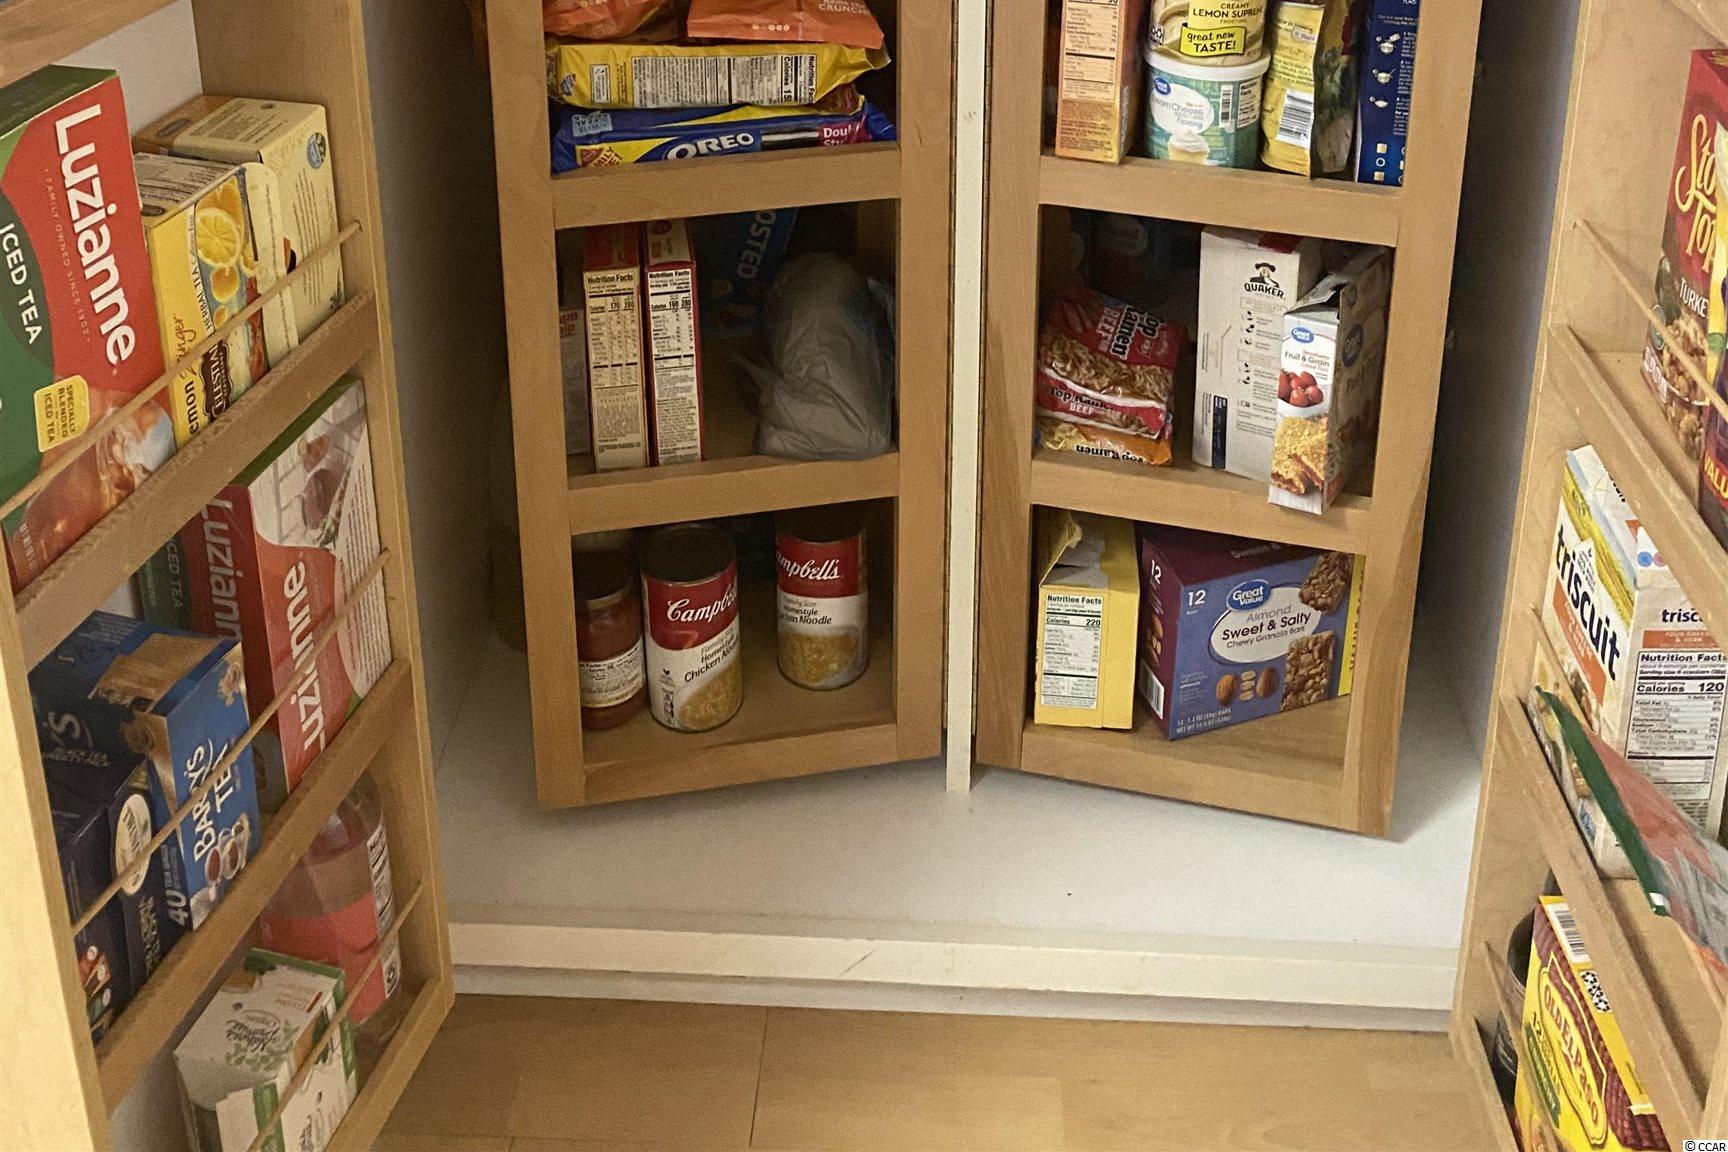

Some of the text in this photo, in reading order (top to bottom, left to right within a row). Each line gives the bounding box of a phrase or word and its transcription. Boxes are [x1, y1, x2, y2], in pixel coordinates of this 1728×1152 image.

[1193, 8, 1229, 18] LEMON
[1187, 31, 1236, 43] great new
[1193, 40, 1237, 53] TASTE!
[783, 55, 791, 87] Calories
[808, 55, 816, 85] Nutrition
[666, 132, 755, 161] OREO
[55, 102, 136, 366] Luzianne
[0, 223, 43, 345] ICED TEA
[588, 273, 634, 284] Nutrition Facts
[649, 271, 674, 279] Nutrition
[1244, 282, 1286, 299] QUAKER
[198, 294, 213, 331] HERBAL
[1284, 351, 1301, 361] Fruit
[1308, 356, 1330, 367] Grain
[44, 392, 56, 443] ICED TEA
[57, 387, 69, 439] BLENDED
[66, 384, 76, 434] SPECIALLY
[1068, 402, 1094, 415] BEEF
[1075, 444, 1120, 459] Ramen
[1150, 559, 1162, 585] 12
[1047, 594, 1102, 605] Nutrition Facts
[1187, 590, 1206, 607] 12
[1232, 584, 1265, 603] Great
[1239, 593, 1264, 607] Value
[1556, 524, 1620, 682] triscuit
[799, 615, 833, 624] Noodle
[1046, 617, 1101, 627] Calories 220
[1246, 604, 1292, 623] Almond
[1222, 611, 1312, 641] Sweet & Salty
[1226, 624, 1305, 650] Chewy Granola Bars
[1641, 653, 1727, 662] Nutrition Facts
[684, 654, 722, 684] Chicken
[1698, 682, 1725, 692] 120
